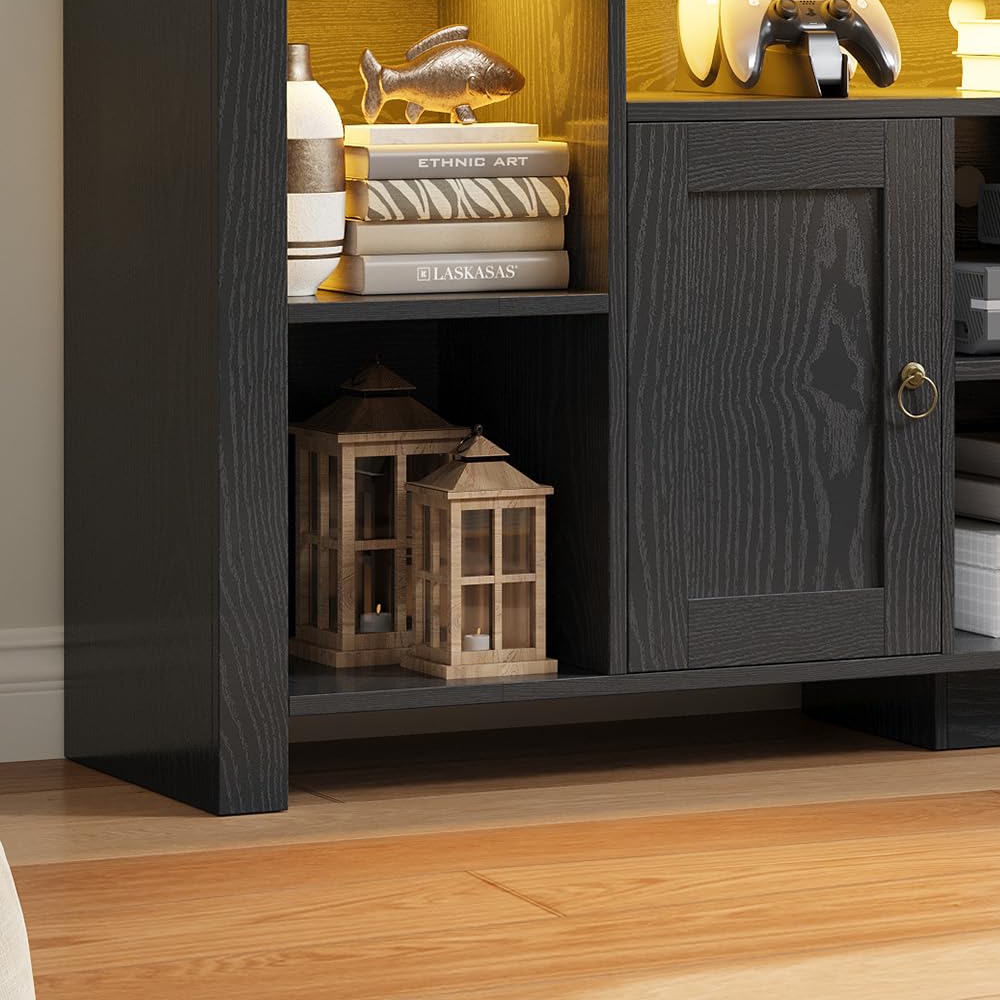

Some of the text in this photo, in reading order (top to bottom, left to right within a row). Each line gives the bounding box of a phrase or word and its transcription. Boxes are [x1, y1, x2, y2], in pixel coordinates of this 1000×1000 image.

[419, 157, 528, 168] ETHNIC ART
[433, 264, 516, 281] LASKASAS
